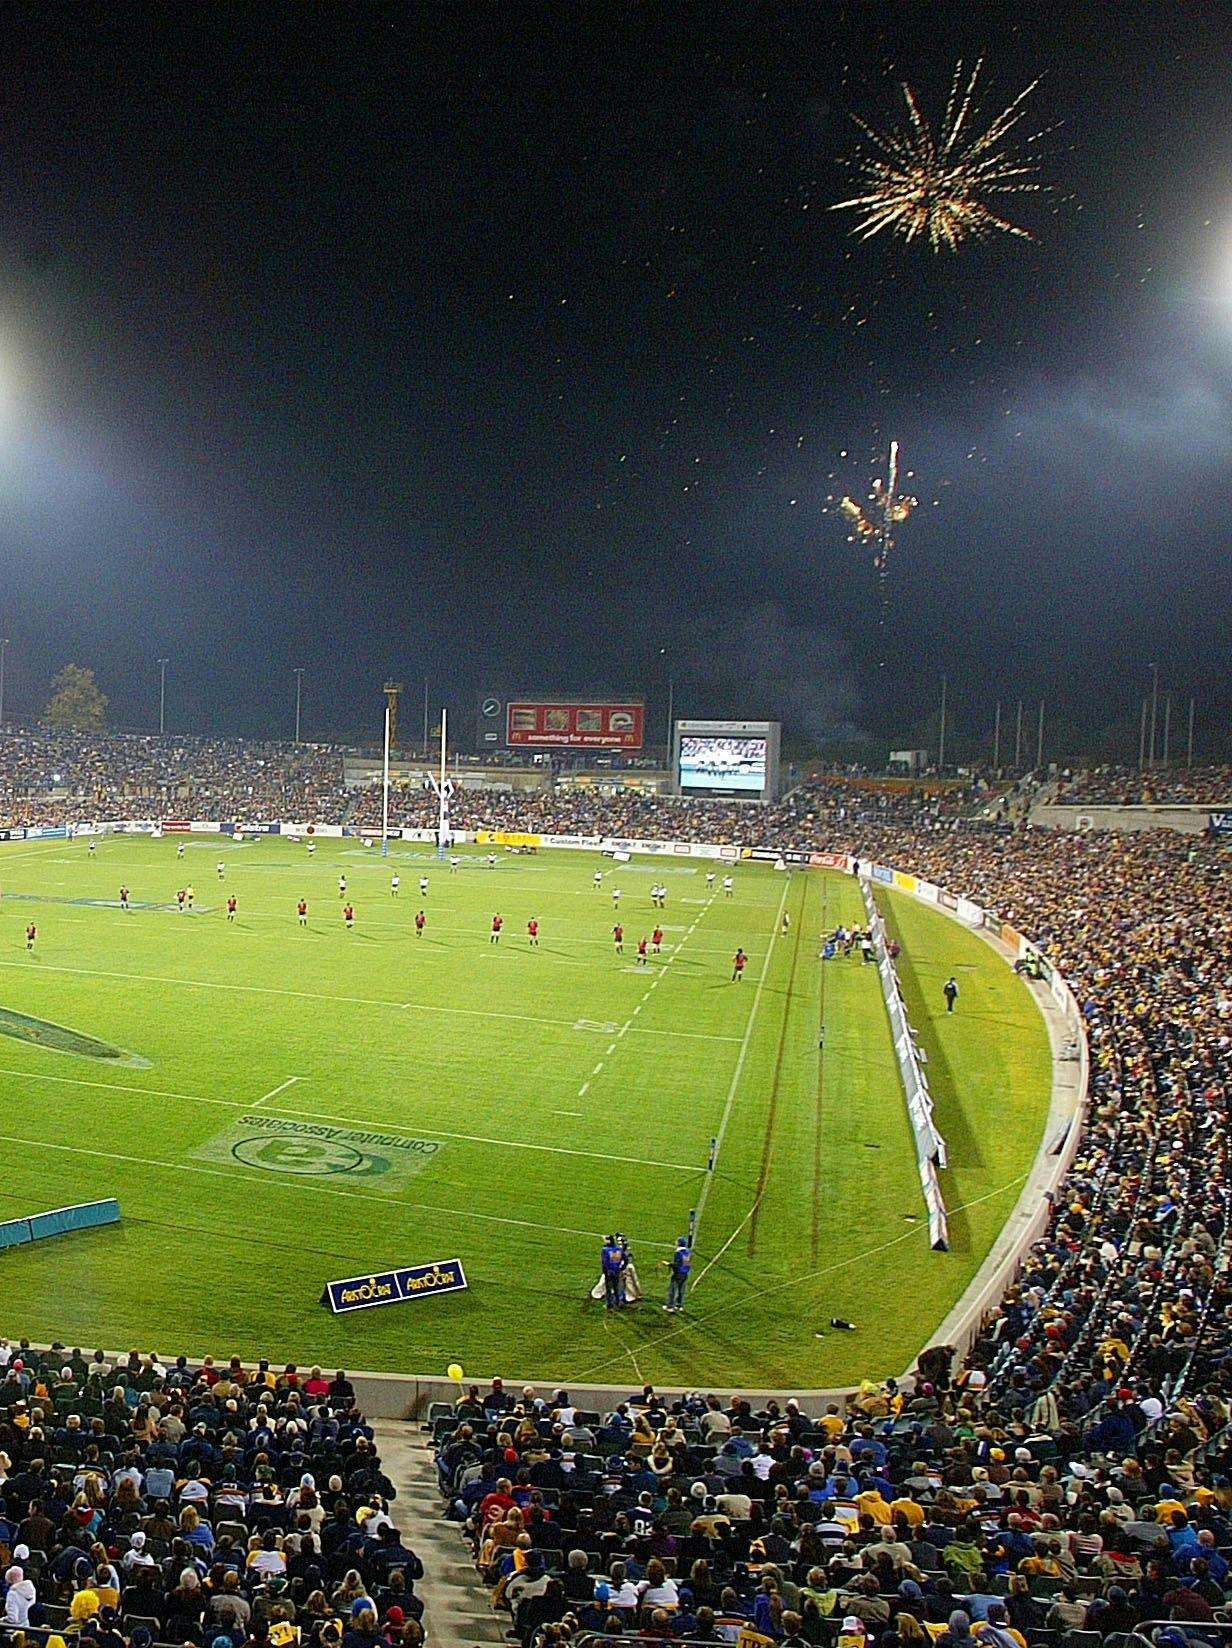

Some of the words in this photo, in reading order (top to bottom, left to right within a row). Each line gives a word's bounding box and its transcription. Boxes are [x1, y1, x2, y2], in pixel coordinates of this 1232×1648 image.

[528, 734, 569, 744] something
[569, 733, 582, 742] for
[584, 736, 621, 745] everyone
[550, 837, 580, 845] Custom
[238, 1116, 345, 1139] Associates
[342, 1130, 439, 1154] Computer
